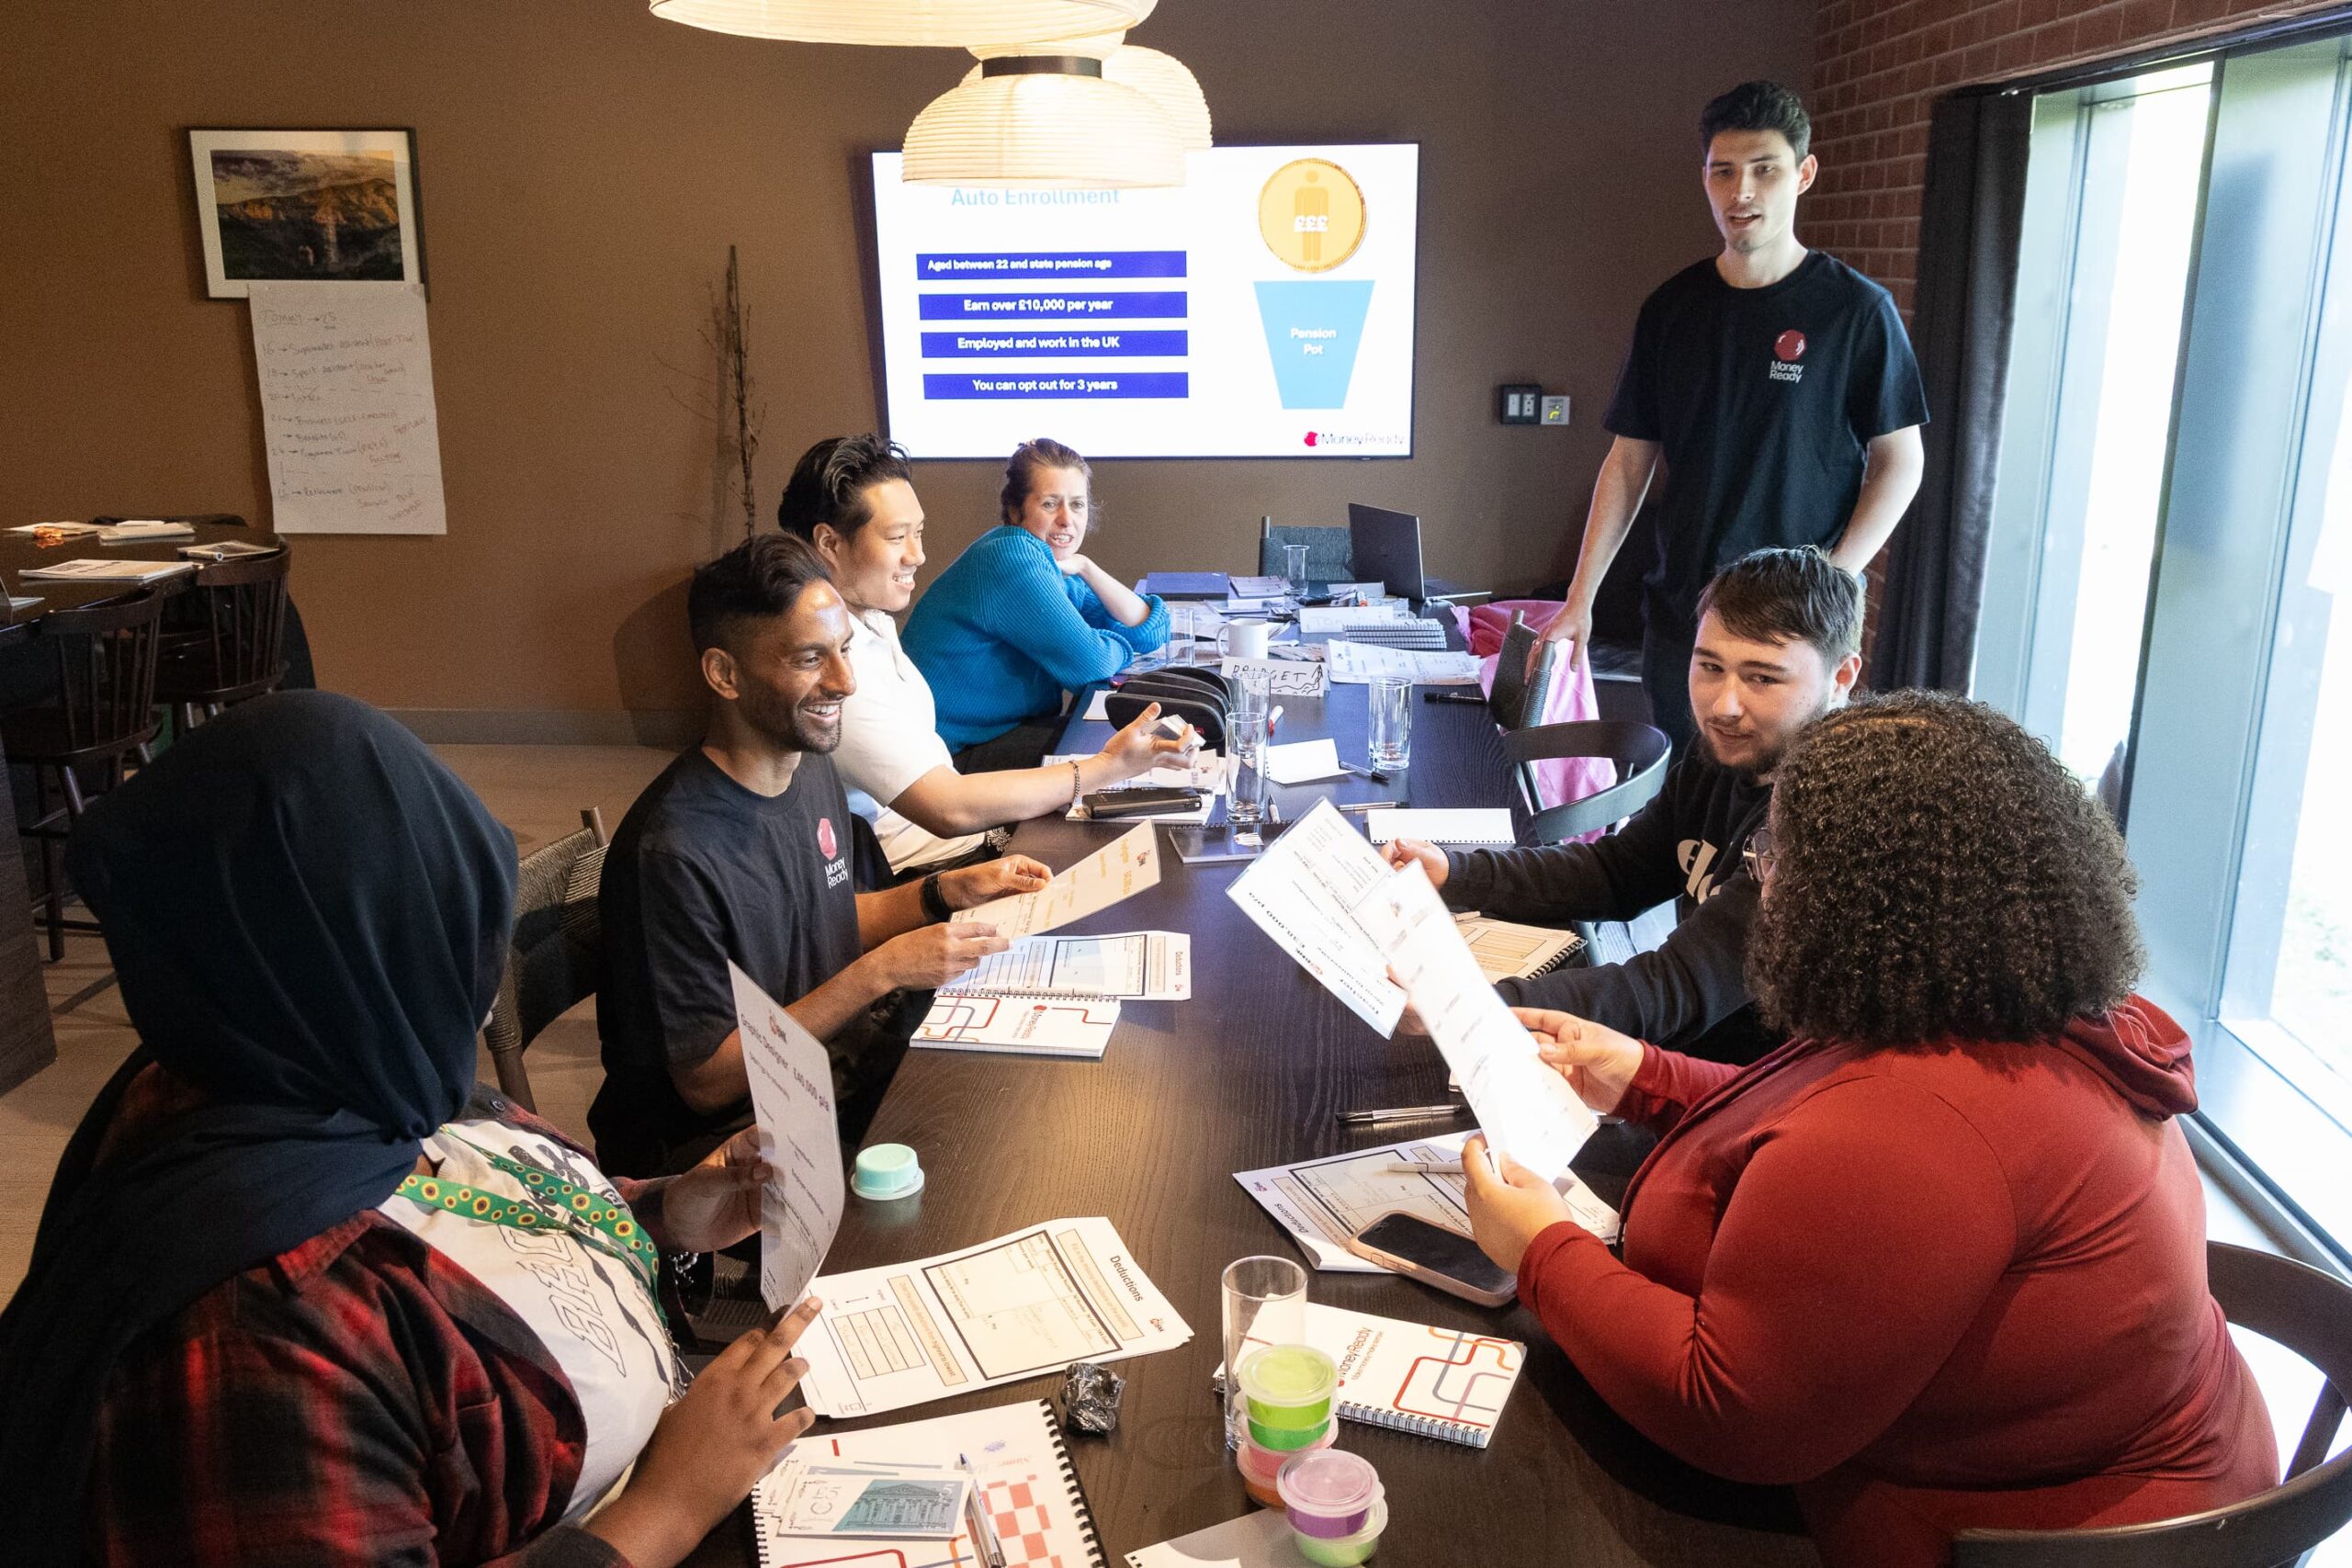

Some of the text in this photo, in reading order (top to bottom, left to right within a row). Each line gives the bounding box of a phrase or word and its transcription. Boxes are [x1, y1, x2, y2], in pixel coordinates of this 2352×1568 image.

[951, 187, 1120, 207] Auto Enrollment
[928, 258, 1112, 273] Aged between 22 and state pension age
[964, 299, 1114, 312] Earn over £10,000 per year
[1290, 328, 1337, 340] Pension
[957, 336, 1120, 351] Employed and work in the UK
[1304, 344, 1324, 355] Pot
[1770, 360, 1804, 375] Money
[1769, 369, 1803, 383] Ready
[972, 379, 1118, 392] You can opt out for 3 years
[824, 856, 845, 877] Money
[827, 868, 848, 889] Ready
[762, 1033, 789, 1075] Designer
[1273, 1201, 1309, 1235] Deductions
[1109, 1254, 1144, 1303] Deductions
[939, 1483, 955, 1497] 5
